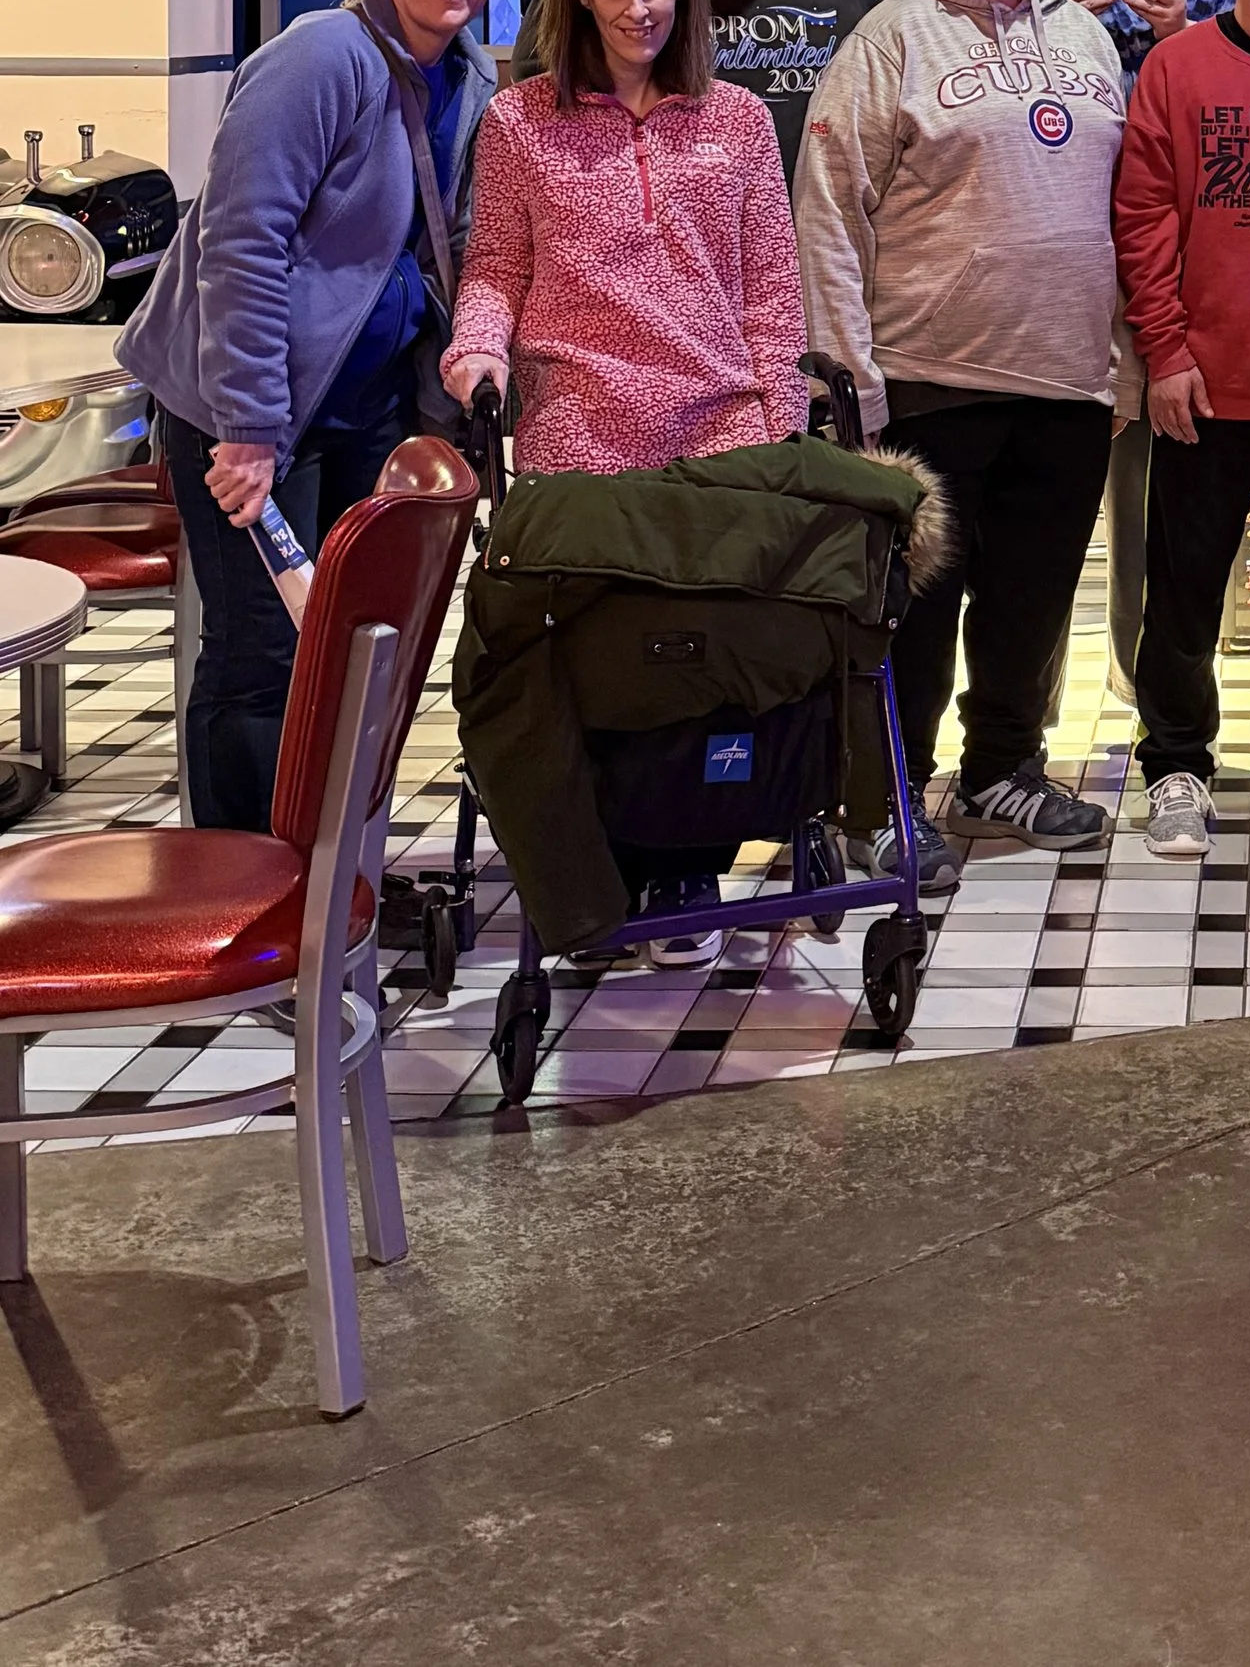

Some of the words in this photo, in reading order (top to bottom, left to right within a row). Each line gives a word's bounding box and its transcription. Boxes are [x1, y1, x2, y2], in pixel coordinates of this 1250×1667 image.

[710, 15, 810, 43] PROM
[713, 35, 837, 70] nlimited
[766, 69, 825, 92] 202
[938, 59, 1121, 115] CUBS
[1200, 106, 1244, 124] LET
[1201, 125, 1226, 136] BUT
[1230, 125, 1242, 136] IF
[1245, 126, 1250, 136] I
[1201, 137, 1250, 158] LET
[1198, 195, 1214, 208] IN
[711, 751, 749, 761] MEDLINE
